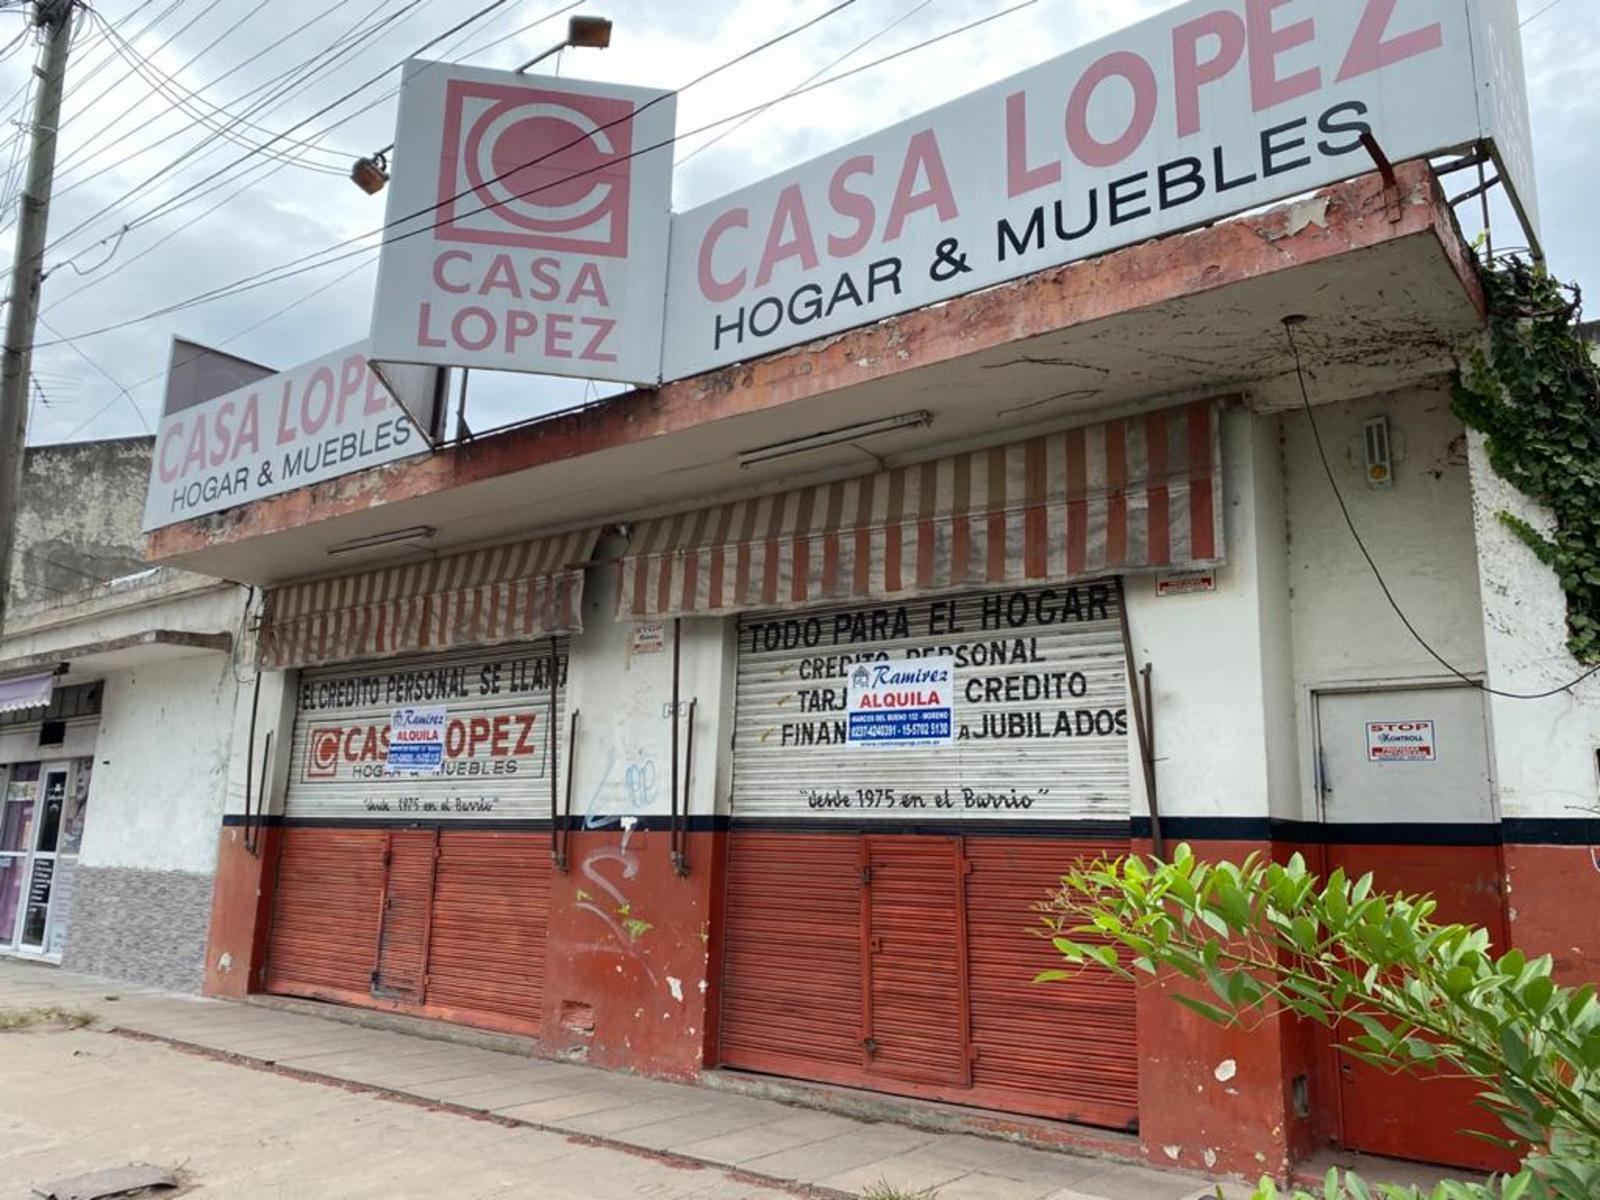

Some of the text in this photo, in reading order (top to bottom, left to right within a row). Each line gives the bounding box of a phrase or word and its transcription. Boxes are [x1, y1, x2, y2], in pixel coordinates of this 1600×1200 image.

[697, 127, 960, 303] CASA
[1005, 0, 1443, 199] LOPEZ
[713, 100, 1372, 351] HOGAR & MUEBLES
[432, 249, 610, 308] CASA
[416, 302, 618, 363] LOPEZ
[158, 353, 399, 484] CASA LOPE
[170, 415, 411, 513] HOGAR & MUEBLES
[748, 584, 1110, 653] TODO PARA EL HOGAR
[302, 682, 316, 710] EL
[319, 678, 380, 709] CREDITO
[385, 666, 469, 705] PERSONAL
[480, 664, 502, 697] SE
[797, 671, 1087, 713] TARJ CREDITO
[872, 665, 948, 688] Ramirez
[403, 709, 444, 726] Ramirez
[860, 690, 941, 708] ALQUILA
[344, 713, 537, 762] CAS OPEZ
[397, 729, 438, 741] ALQUILA
[780, 708, 1128, 747] FINAN A JUBILADOS
[1371, 723, 1429, 732] STOP
[398, 796, 420, 812] 1975
[856, 788, 896, 809] 1975
[899, 793, 927, 809] en
[935, 788, 955, 809] el
